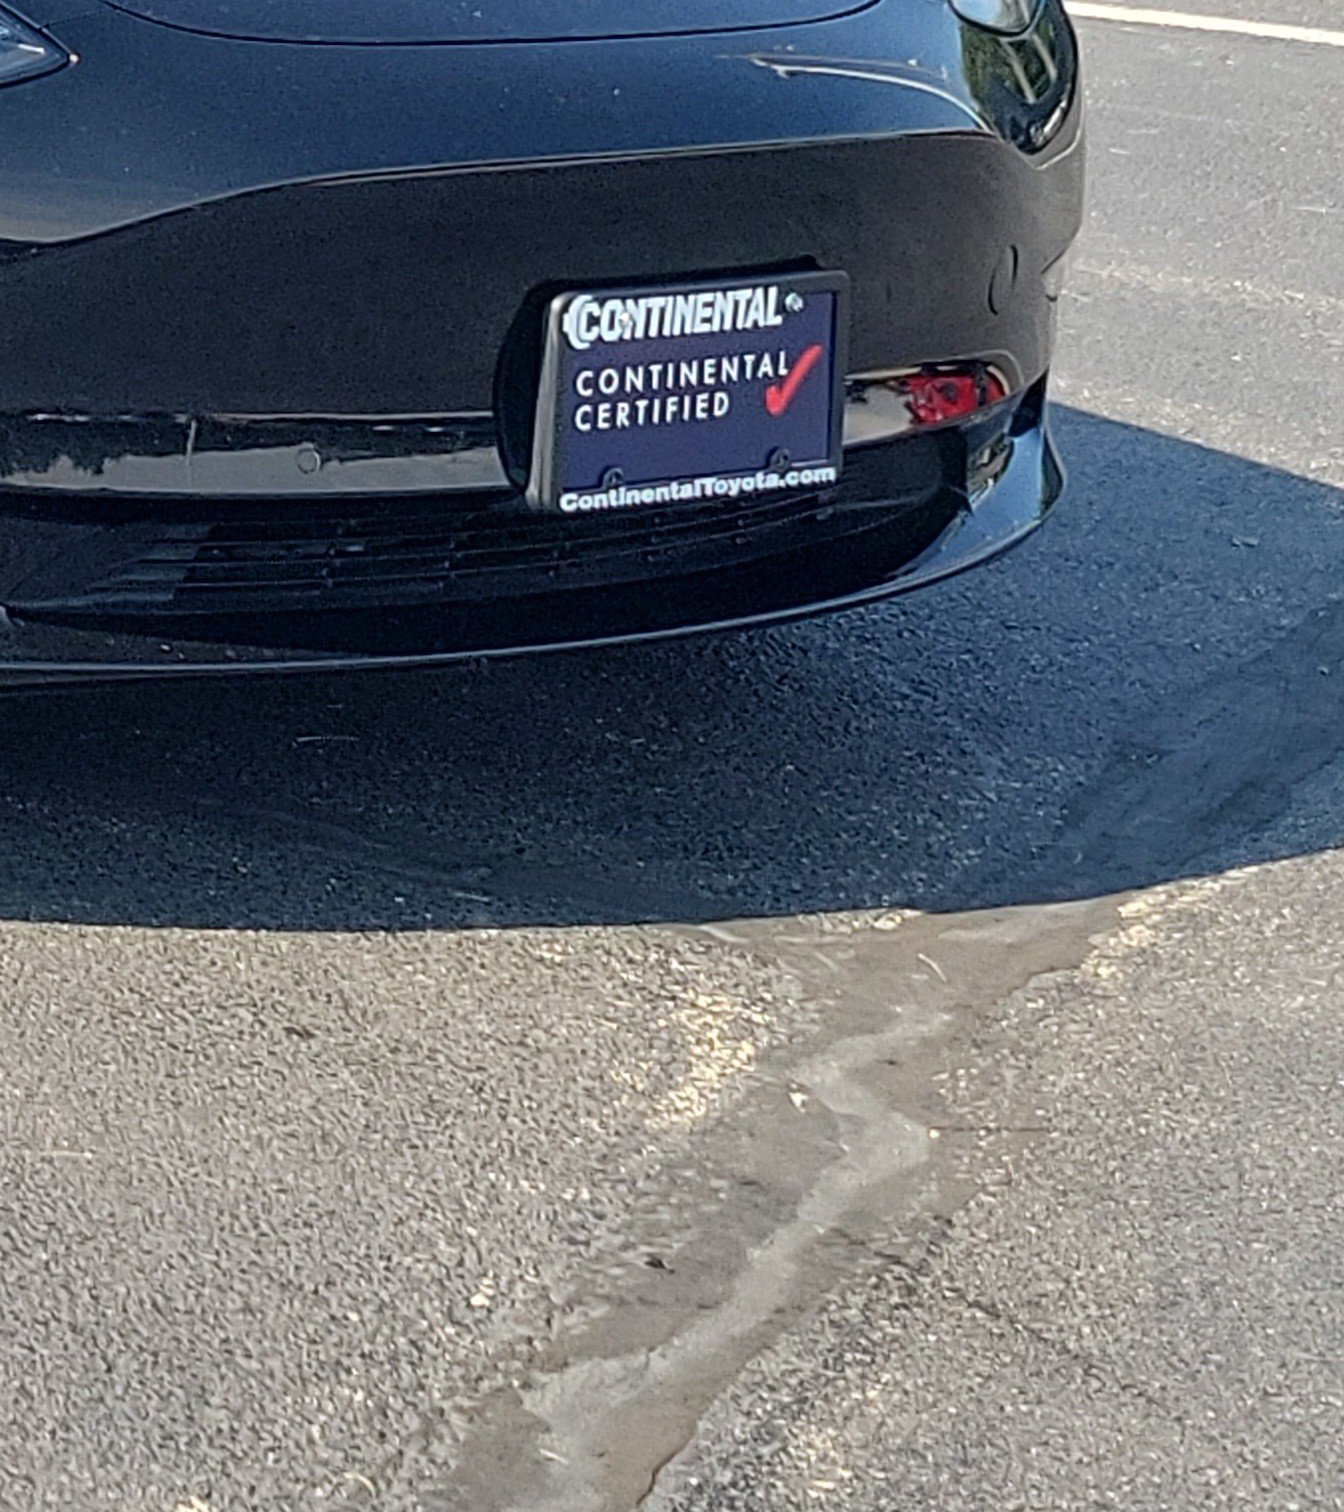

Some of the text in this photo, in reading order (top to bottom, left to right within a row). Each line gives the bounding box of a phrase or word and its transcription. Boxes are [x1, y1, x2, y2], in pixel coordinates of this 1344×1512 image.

[564, 286, 783, 349] CONTINENTAL
[576, 350, 790, 396] CONTINENTAL
[575, 391, 730, 431] CERTIFIED
[560, 467, 836, 512] ContinentalToyota.com
